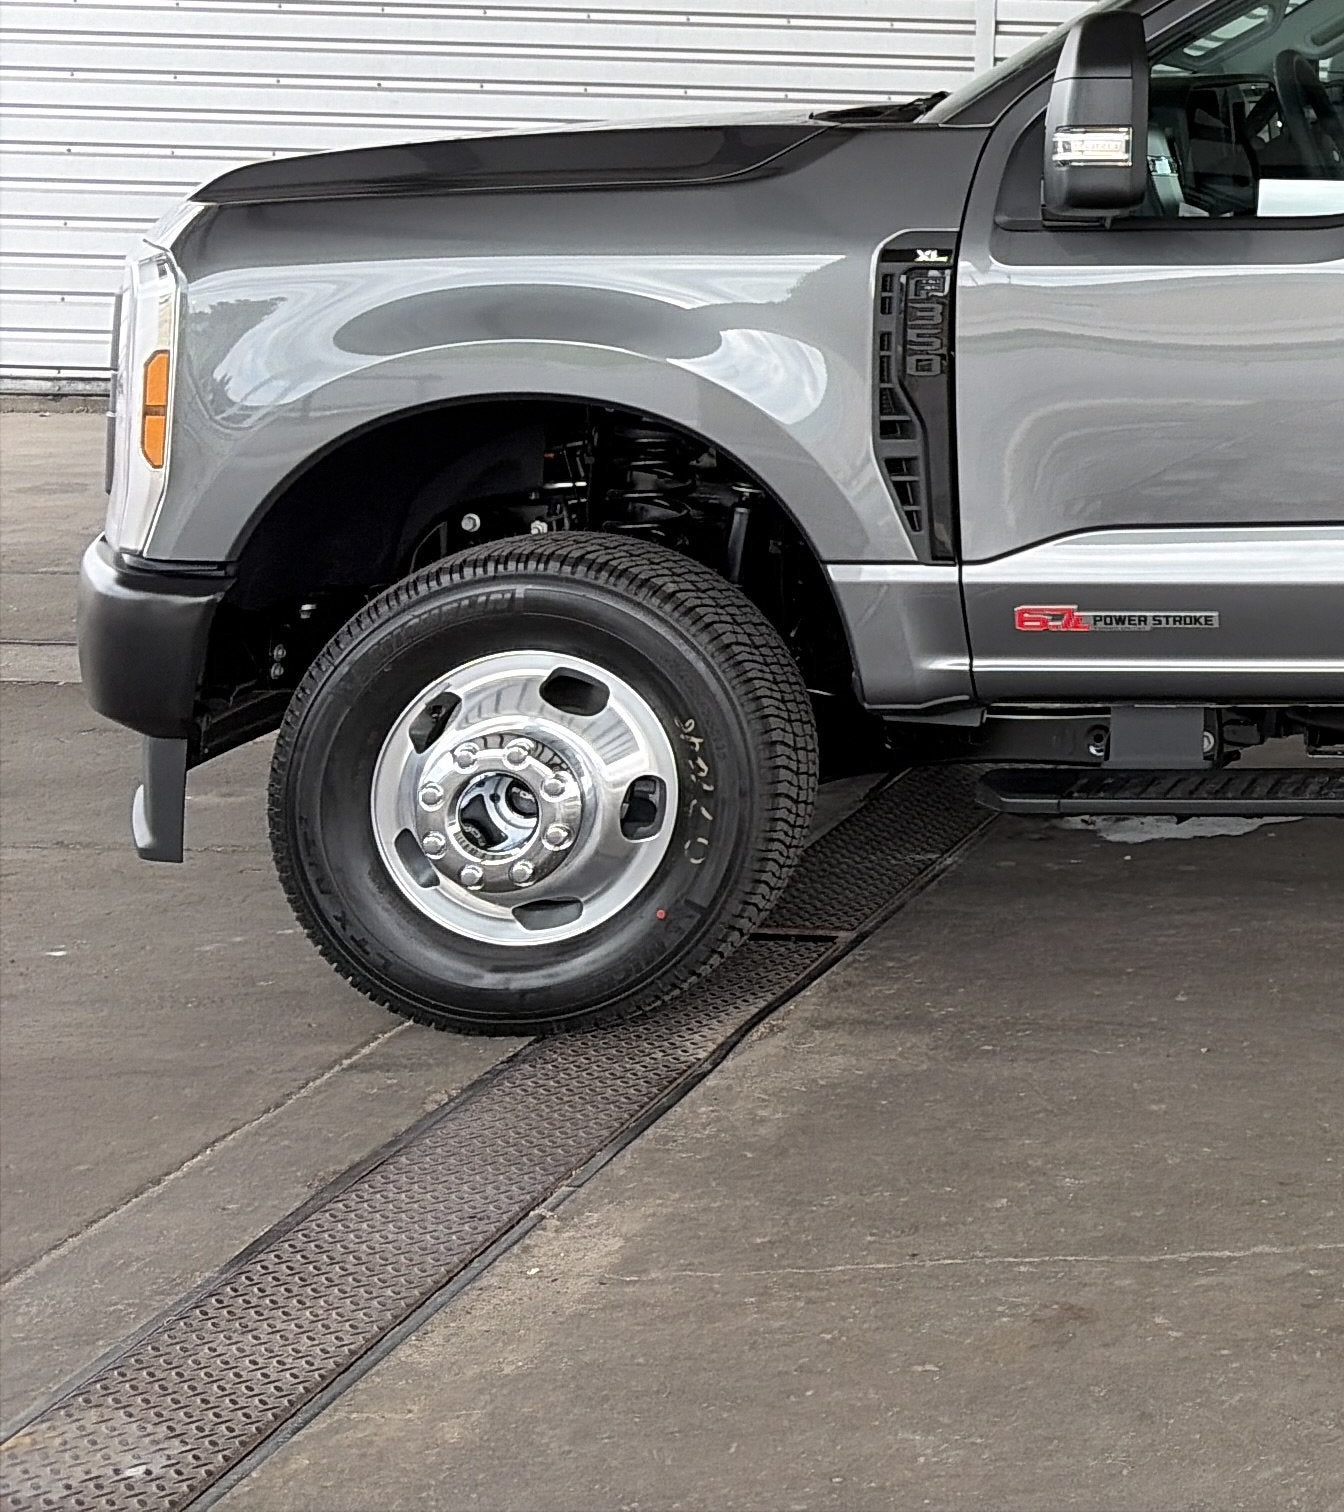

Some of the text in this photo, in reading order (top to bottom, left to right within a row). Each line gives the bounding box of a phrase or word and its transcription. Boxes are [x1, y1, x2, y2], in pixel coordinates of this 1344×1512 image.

[914, 249, 948, 263] XL
[1092, 615, 1148, 626] POWER
[1152, 615, 1213, 626] STROKE
